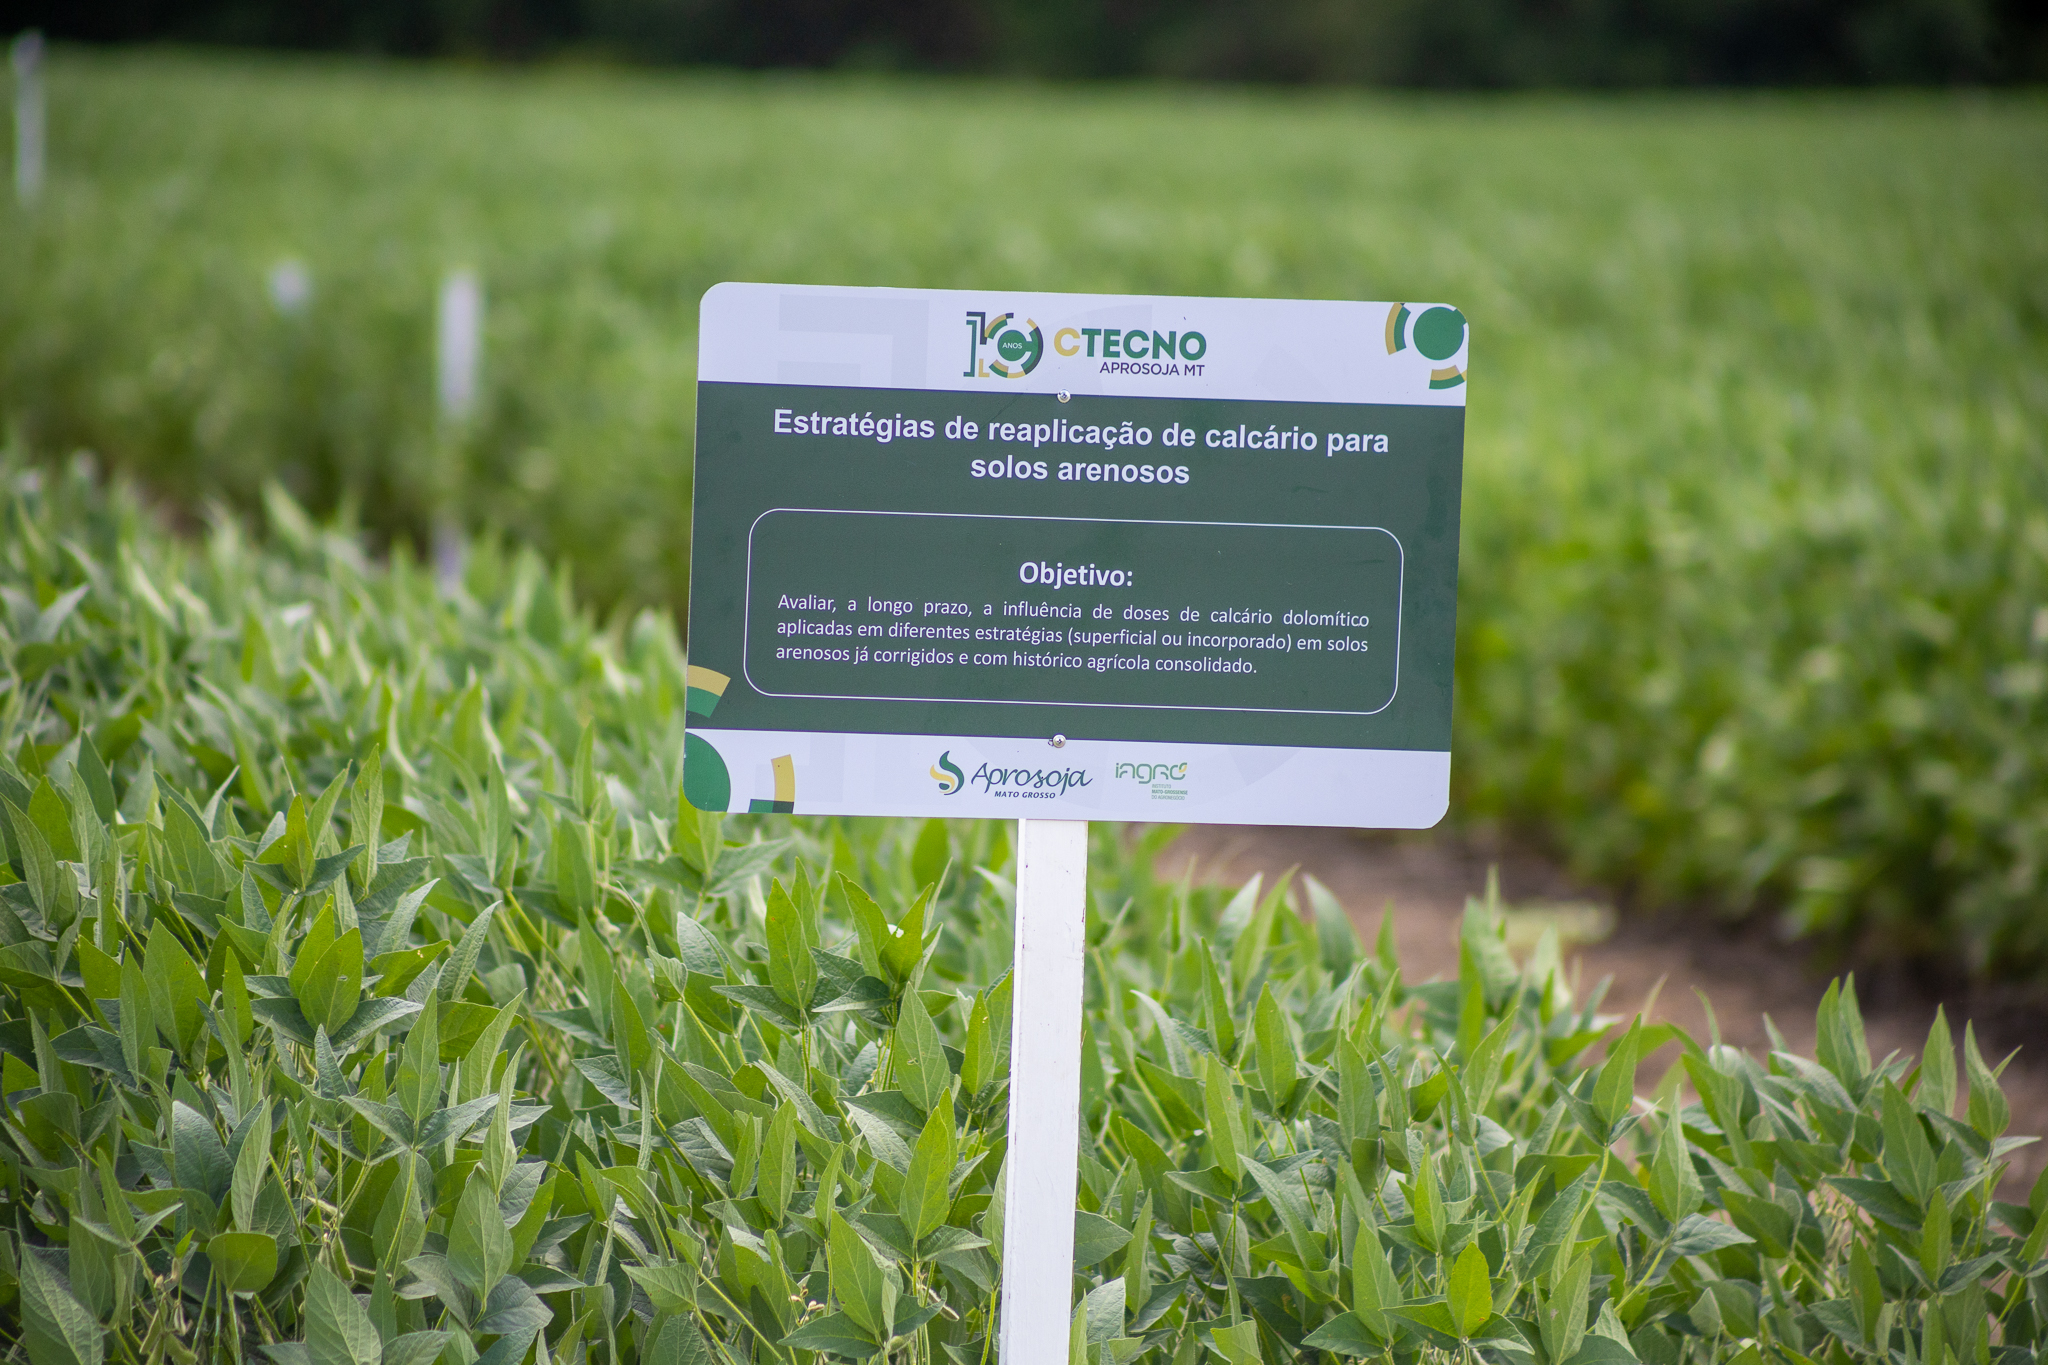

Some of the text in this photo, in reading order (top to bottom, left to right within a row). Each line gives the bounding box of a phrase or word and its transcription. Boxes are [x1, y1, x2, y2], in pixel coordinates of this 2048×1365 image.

[1002, 342, 1023, 350] ANOS
[1053, 327, 1207, 361] CTECNO
[1099, 361, 1206, 377] APROSOJA MT
[773, 408, 1390, 457] Estratégias de reaplicação de calcário para
[970, 454, 1190, 485] solos arenosos
[1019, 561, 1133, 589] Objetivo:
[778, 594, 1370, 627] Avaliar, a longo prazo, a influência de doses de calcário dolomítico
[777, 619, 1369, 653] aplicadas em diferentes estratégias (superficial ou incorporado) em solos
[776, 646, 1257, 674] arenosos já corrigidos e com histórico agrícola consolidado.
[971, 762, 1093, 796] Aprosoja
[994, 790, 1056, 799] MATO GROSSO
